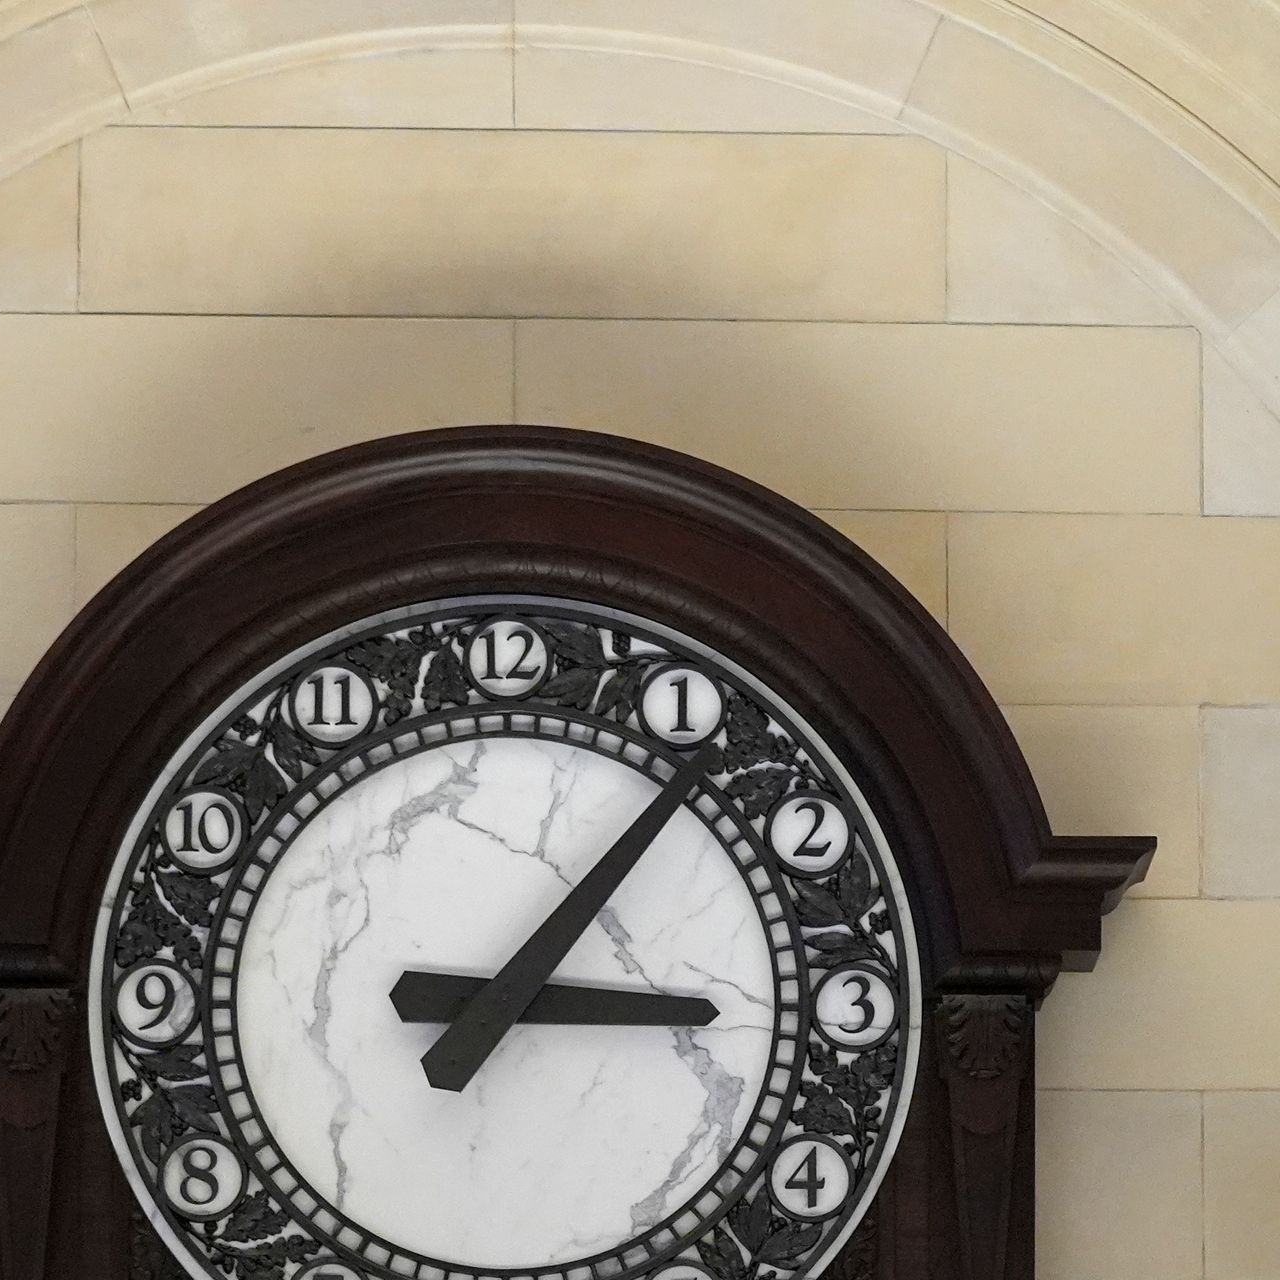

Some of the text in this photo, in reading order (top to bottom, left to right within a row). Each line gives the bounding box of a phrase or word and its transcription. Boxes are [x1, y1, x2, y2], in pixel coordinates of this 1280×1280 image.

[477, 629, 540, 680] 12
[307, 675, 358, 727] 11
[669, 676, 697, 733] 1
[175, 802, 234, 855] 10
[793, 802, 832, 857] 2
[136, 972, 175, 1030] 9
[839, 976, 874, 1033] 3
[180, 1147, 220, 1205] 8
[784, 1146, 826, 1209] 4
